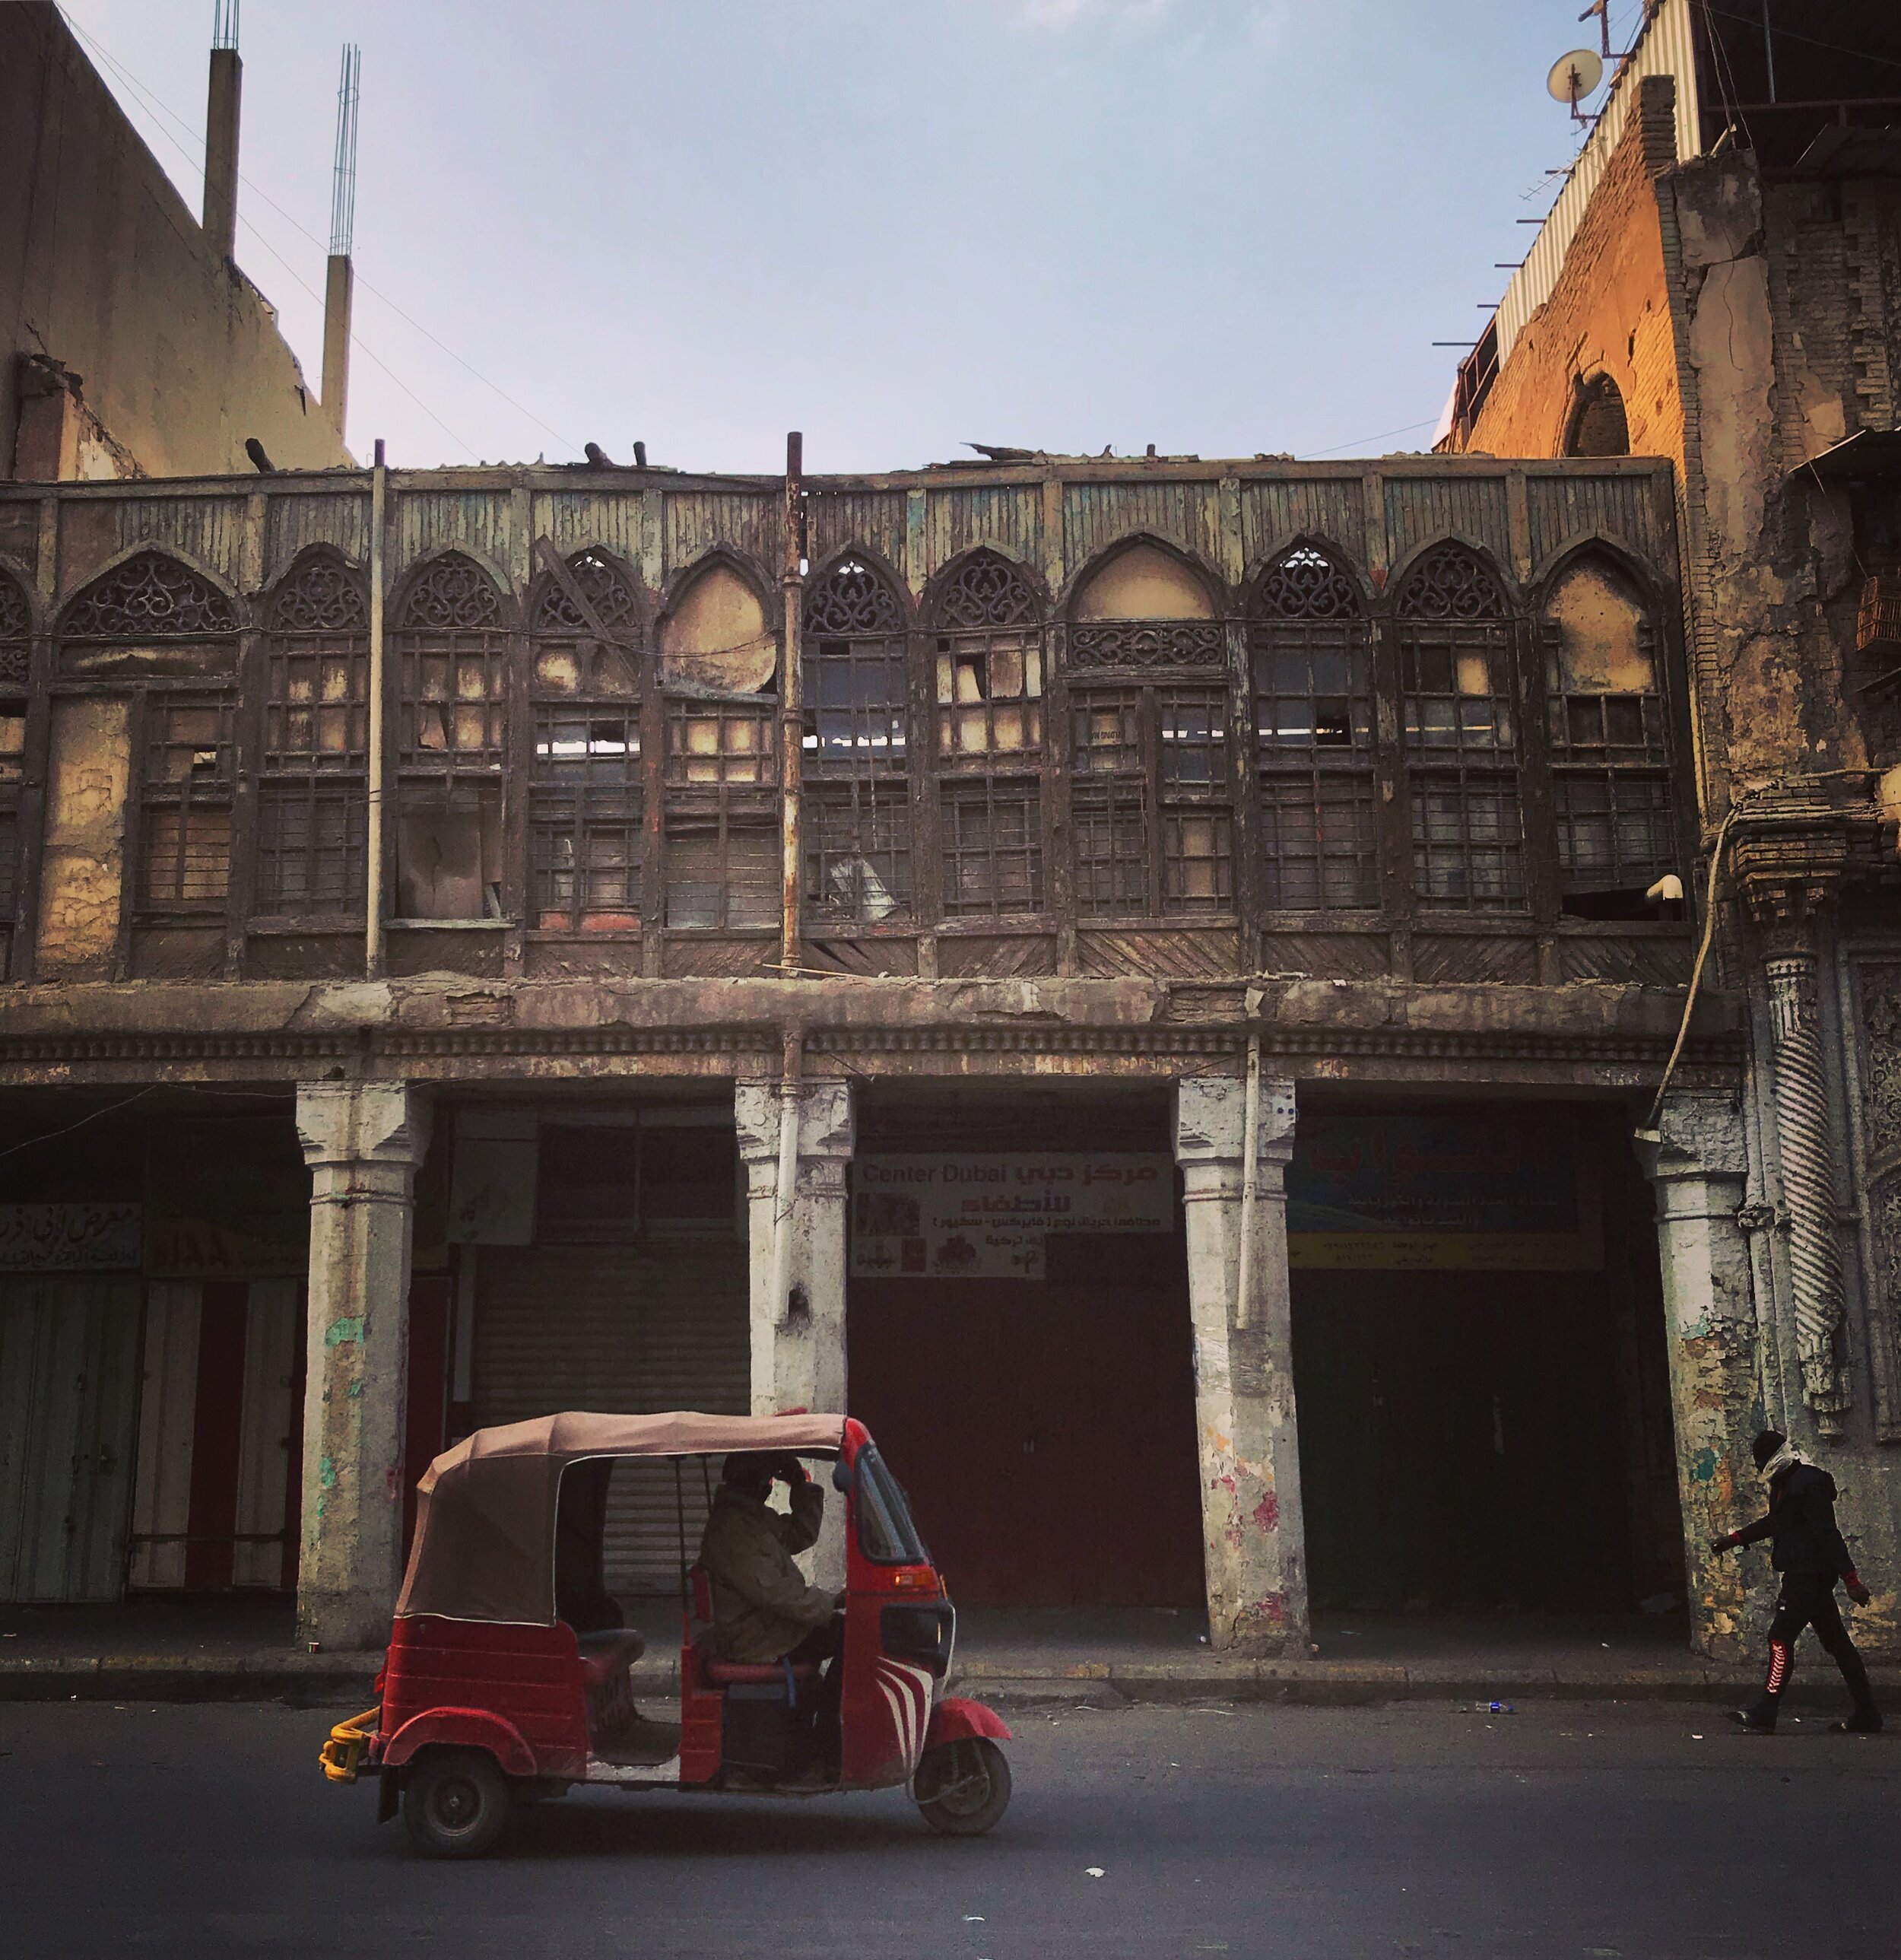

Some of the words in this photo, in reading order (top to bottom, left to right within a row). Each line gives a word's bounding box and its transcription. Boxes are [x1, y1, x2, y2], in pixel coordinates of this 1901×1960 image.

[862, 1164, 936, 1183] Center
[942, 1164, 1007, 1183] Dubai
[1015, 1165, 1074, 1185] دبي
[1081, 1164, 1159, 1185] مركز
